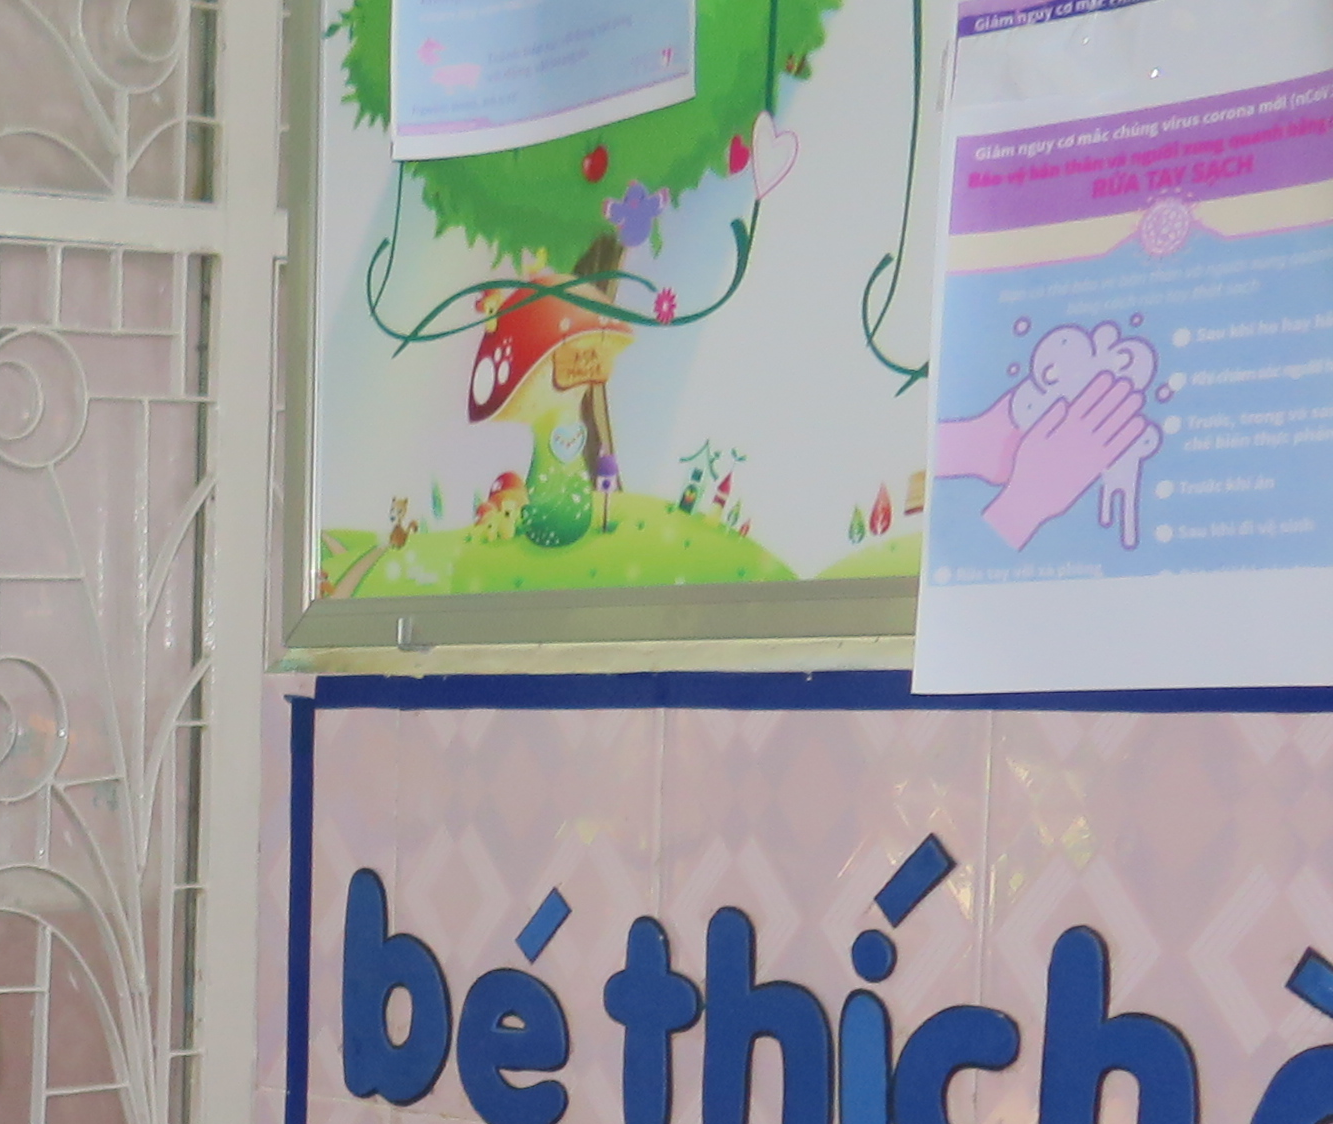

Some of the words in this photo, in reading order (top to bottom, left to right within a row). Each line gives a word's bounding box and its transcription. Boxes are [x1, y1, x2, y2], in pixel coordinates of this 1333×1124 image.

[1202, 104, 1256, 124] corona
[1146, 166, 1188, 191] TAY
[1192, 154, 1255, 187] SẠCH
